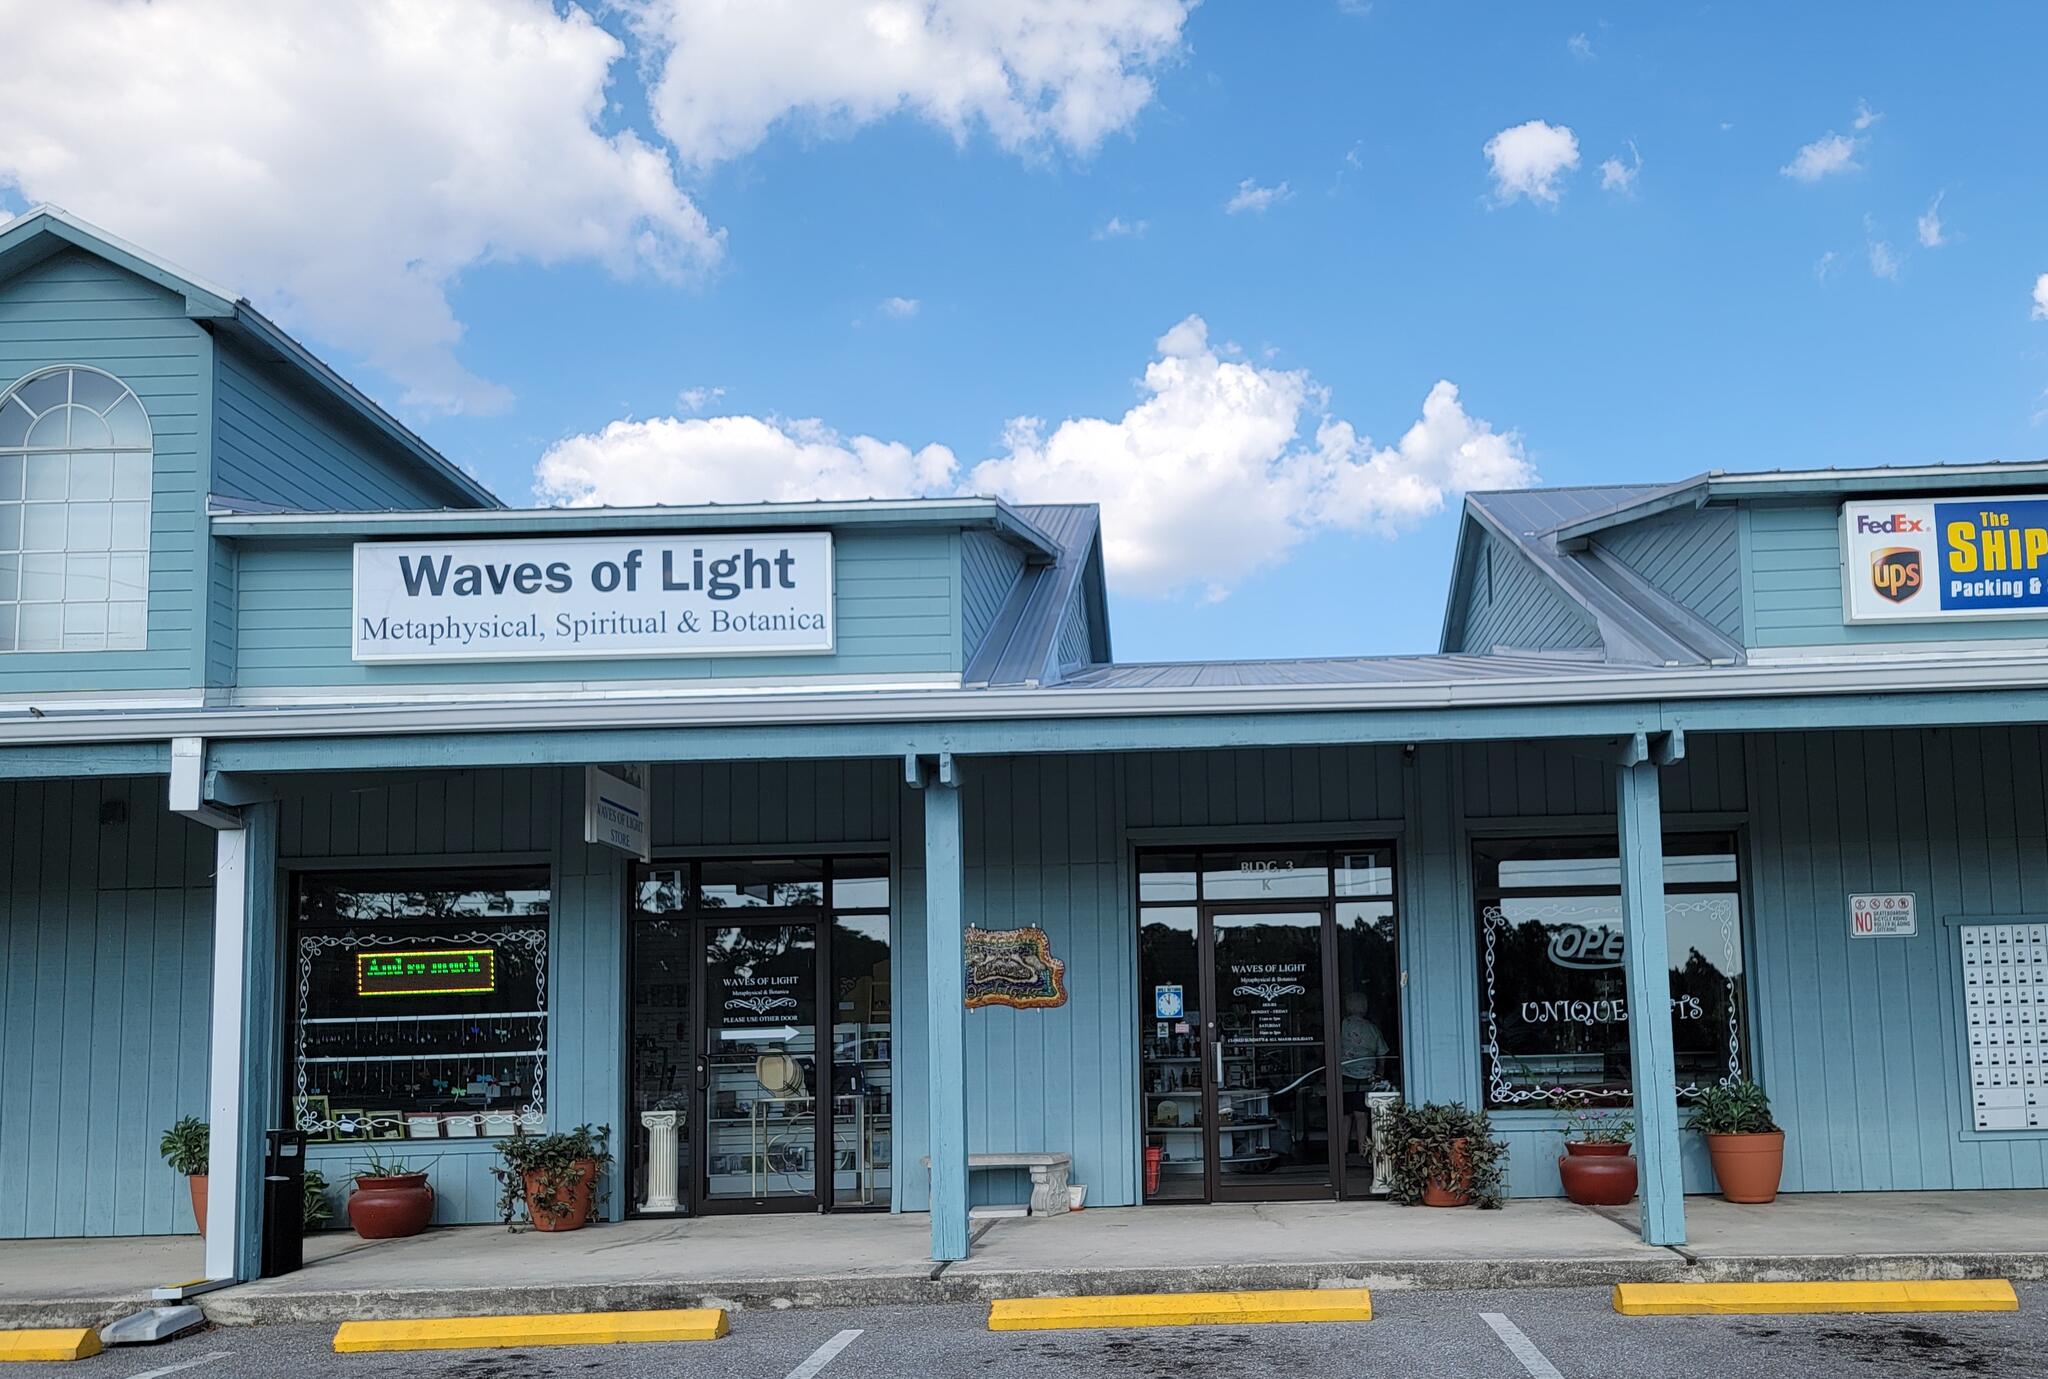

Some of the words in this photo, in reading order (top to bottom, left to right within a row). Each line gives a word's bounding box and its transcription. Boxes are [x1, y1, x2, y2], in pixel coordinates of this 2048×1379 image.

[1857, 514, 1924, 534] FedEx
[1980, 511, 2010, 527] The
[399, 554, 573, 597] Waves
[591, 549, 643, 593] of
[662, 548, 796, 601] Light
[1874, 563, 1920, 597] ups
[1951, 578, 2024, 598] Packing
[2029, 577, 2042, 595] &
[361, 614, 547, 646] Metaphysical,
[555, 609, 667, 642] Spiritual
[677, 610, 701, 634] &
[710, 607, 826, 633] Botanica
[610, 829, 631, 848] STORE
[1240, 860, 1281, 874] BLDG.
[1286, 860, 1295, 873] 3
[1262, 879, 1273, 891] K
[1855, 911, 1873, 933] NO
[1555, 928, 1625, 959] OPE
[1231, 964, 1263, 974] WAVES
[1264, 964, 1277, 973] OF
[1278, 963, 1307, 973] LIGHT
[723, 978, 756, 987] WAVES
[757, 977, 770, 986] OF
[771, 976, 799, 986] LIGHT
[1521, 999, 1629, 1026] UNIQUE
